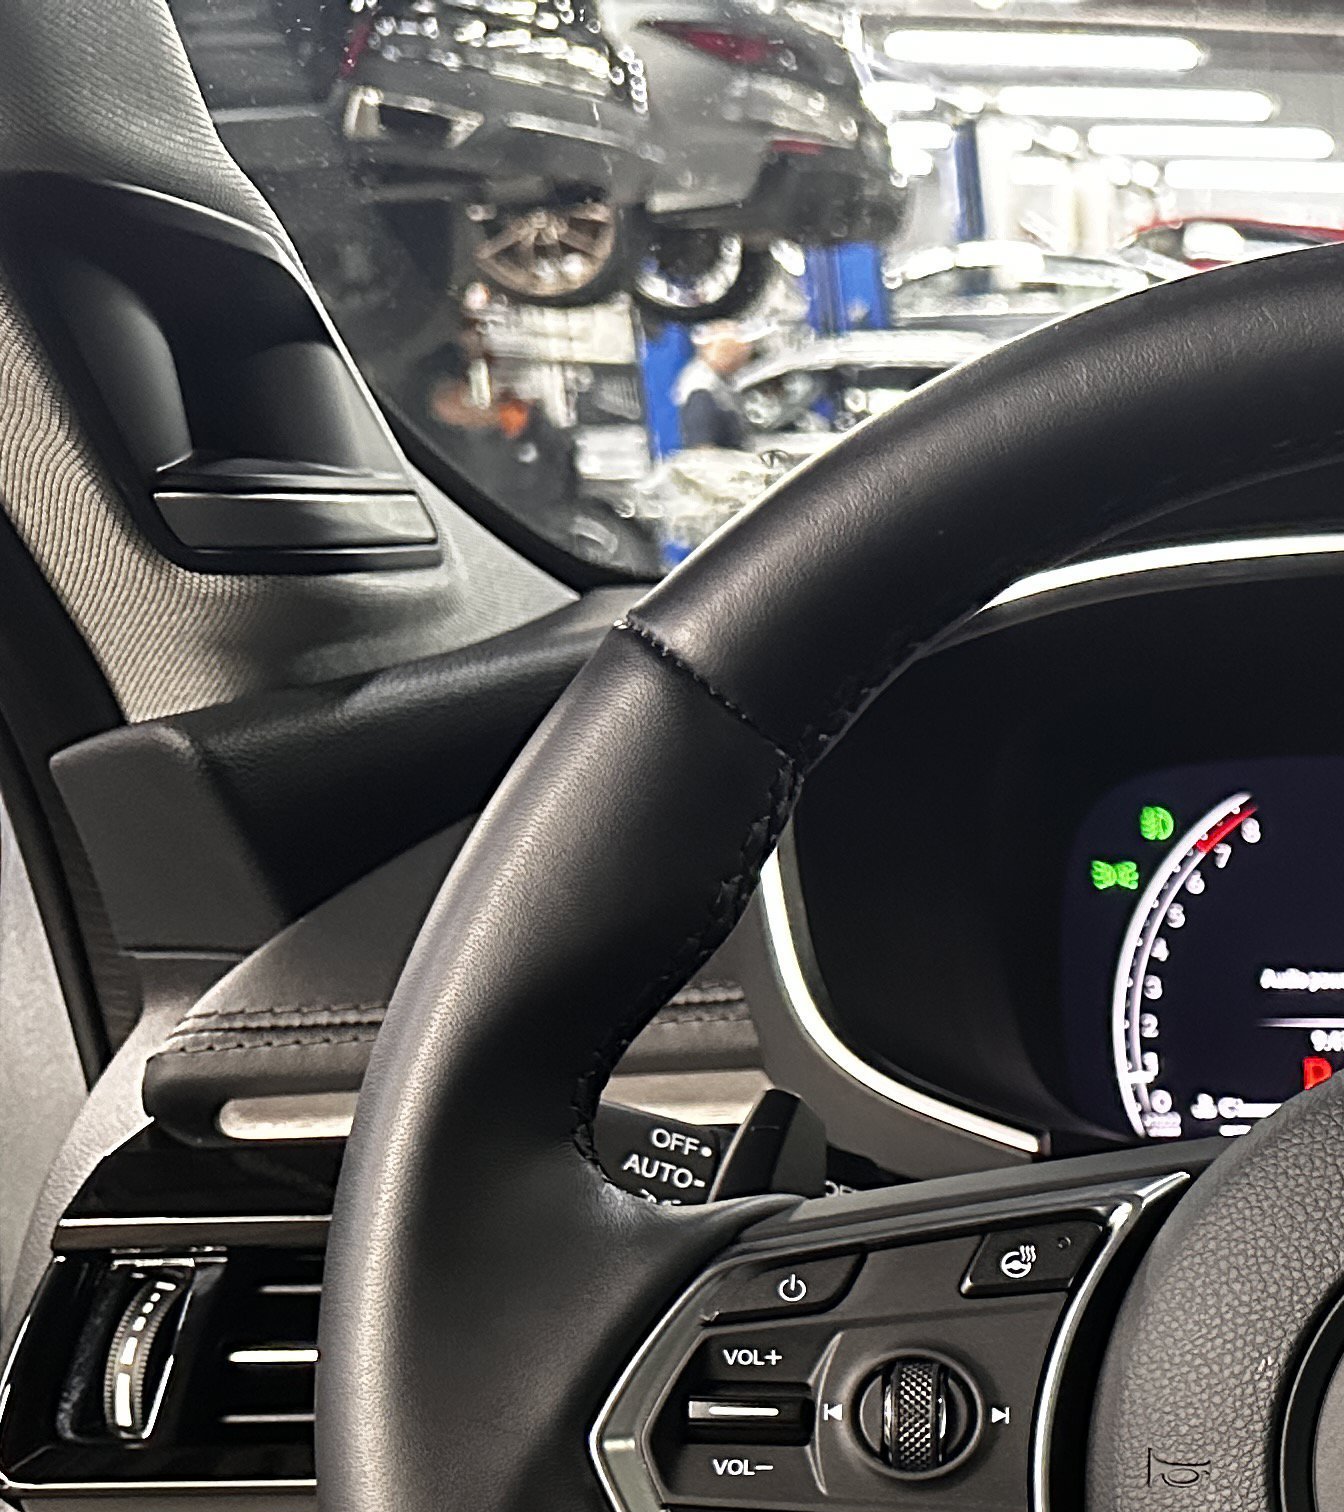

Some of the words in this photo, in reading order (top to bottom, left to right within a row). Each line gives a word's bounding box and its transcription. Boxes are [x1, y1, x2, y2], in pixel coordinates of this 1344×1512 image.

[1213, 843, 1231, 868] 7
[1186, 869, 1205, 895] 6
[1150, 937, 1170, 962] 4
[1144, 975, 1163, 1000] 3
[1141, 1013, 1158, 1039] 2
[652, 1128, 700, 1156] OFF
[622, 1153, 694, 1189] AUTO
